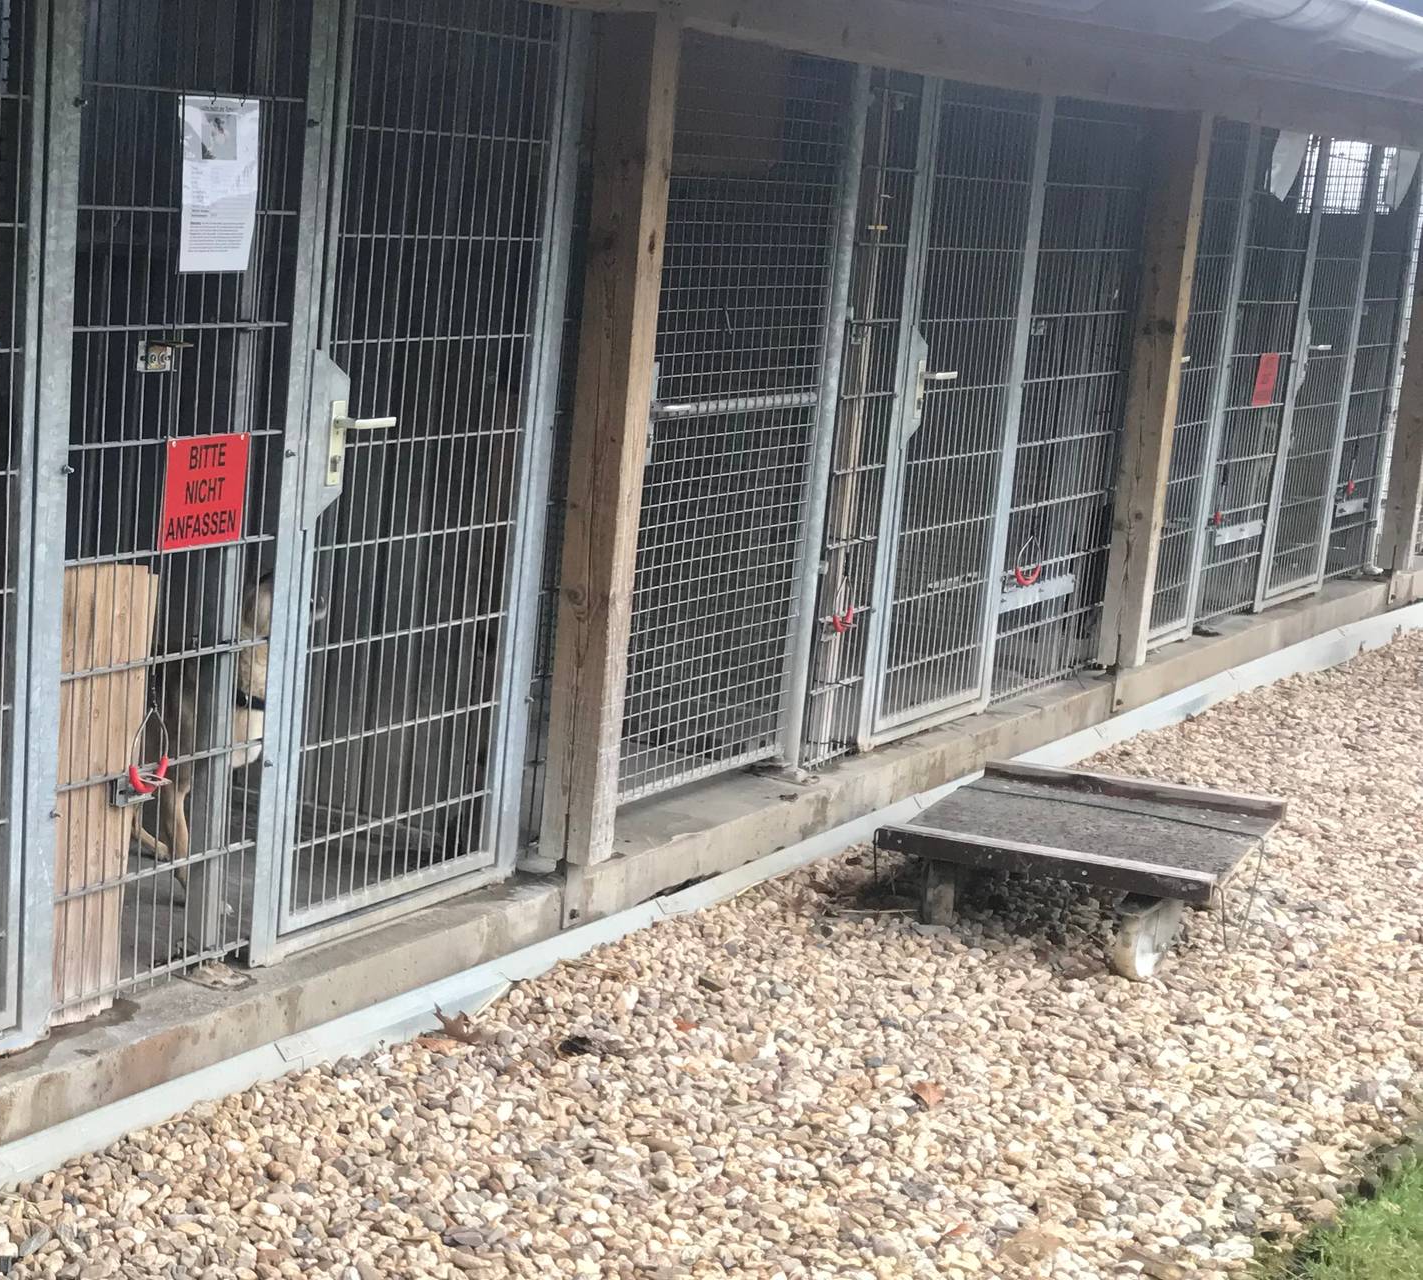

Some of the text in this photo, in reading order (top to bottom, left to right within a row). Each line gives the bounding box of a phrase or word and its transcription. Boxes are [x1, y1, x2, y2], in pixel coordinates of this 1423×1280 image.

[189, 443, 227, 470] BITTE
[185, 477, 225, 505] NICHT
[165, 509, 237, 542] ANFASSEN
